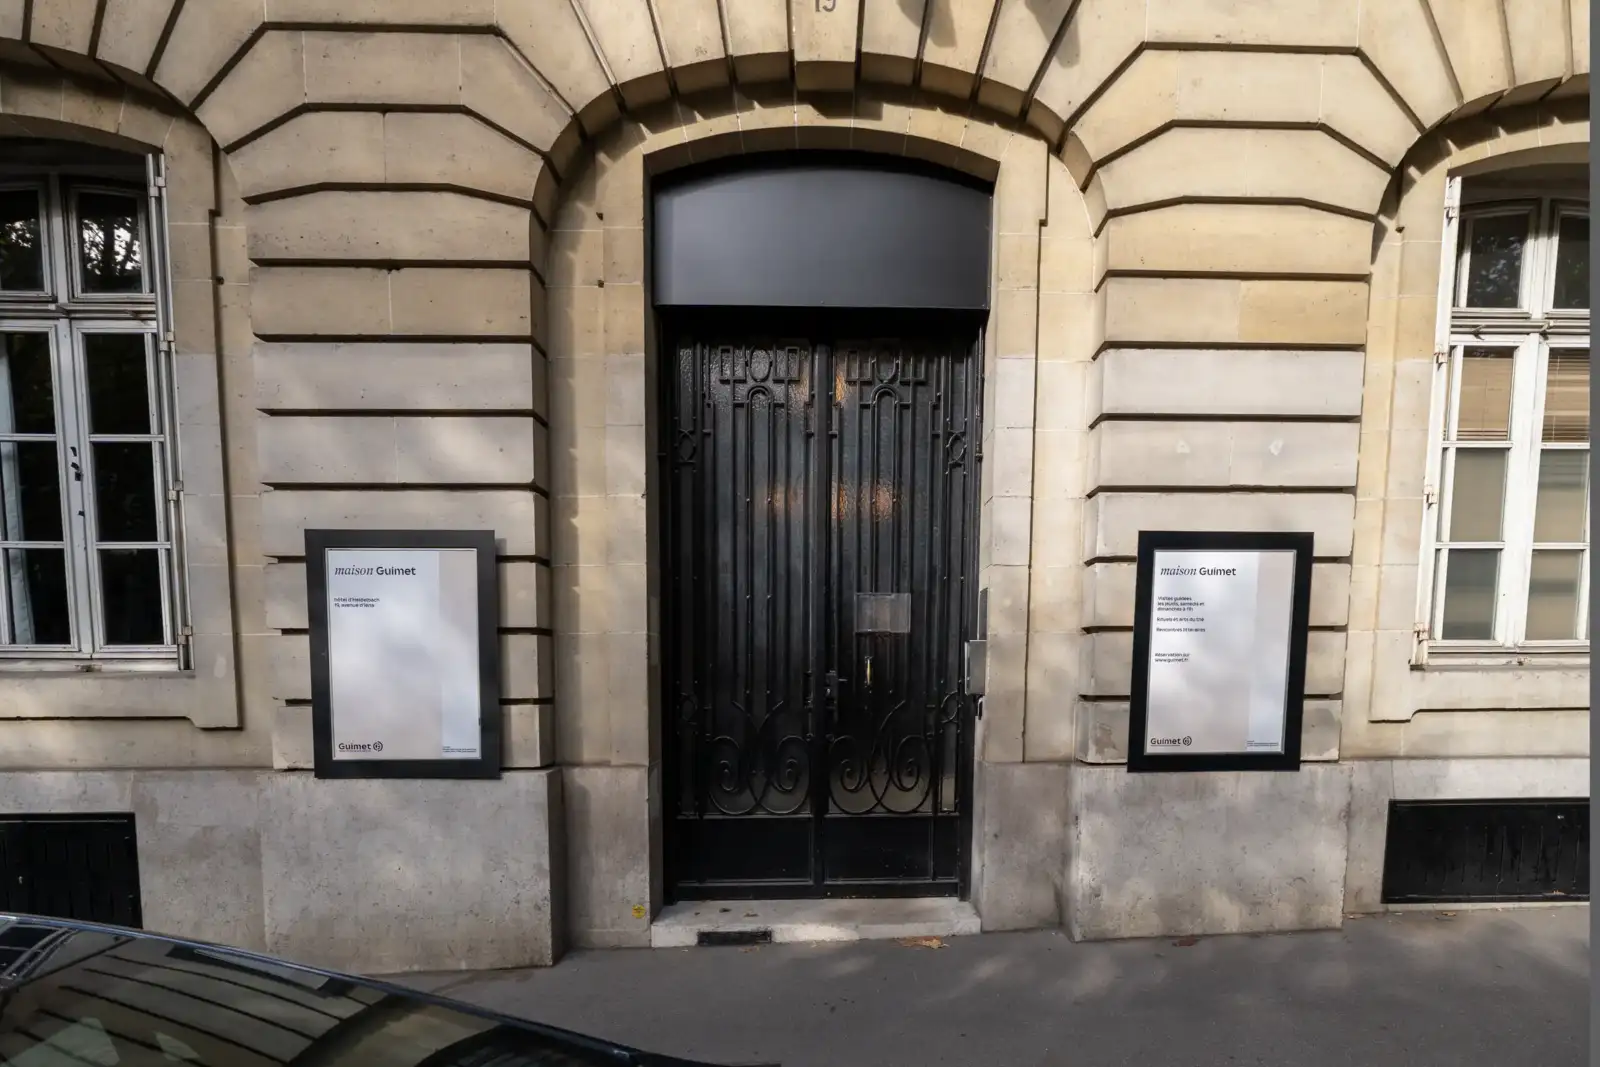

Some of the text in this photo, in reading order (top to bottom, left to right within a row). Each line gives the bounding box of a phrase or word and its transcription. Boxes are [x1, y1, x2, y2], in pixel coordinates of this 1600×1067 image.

[334, 564, 416, 576] maison Guimet
[1160, 565, 1237, 576] maison Guimet
[1150, 737, 1181, 745] Guimet
[338, 742, 372, 750] Guimet
